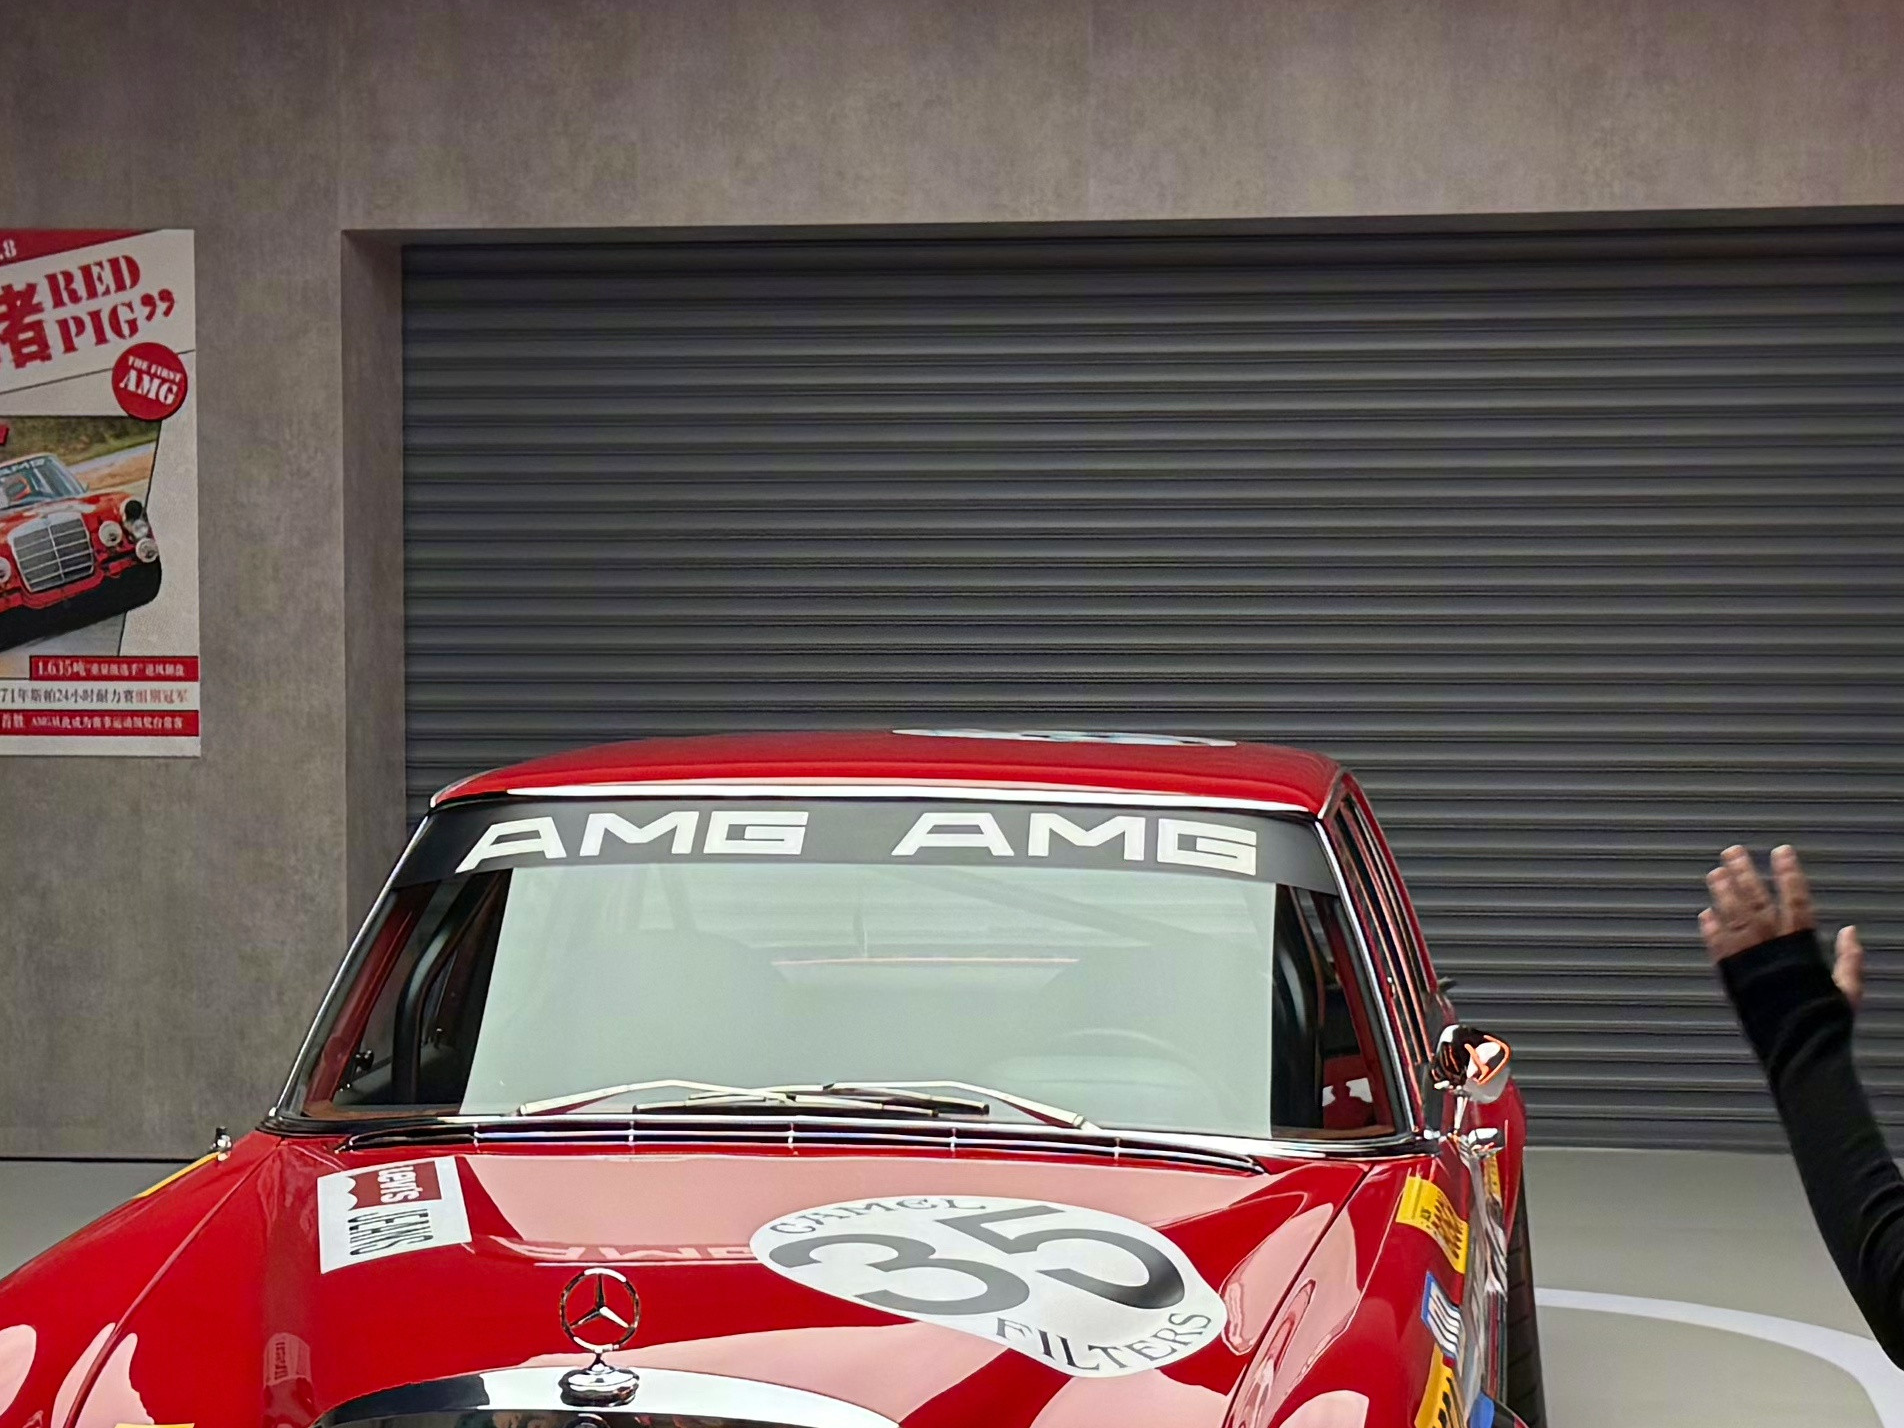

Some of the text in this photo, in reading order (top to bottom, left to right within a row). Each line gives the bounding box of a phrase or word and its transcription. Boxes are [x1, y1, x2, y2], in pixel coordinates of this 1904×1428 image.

[44, 255, 141, 310] RED
[119, 369, 178, 405] AMG
[455, 809, 1258, 876] AMG AMG
[347, 1208, 434, 1256] JEANS
[769, 1198, 987, 1235] CAMEL
[768, 1205, 1186, 1316] 35
[995, 1311, 1213, 1371] FILTERS
